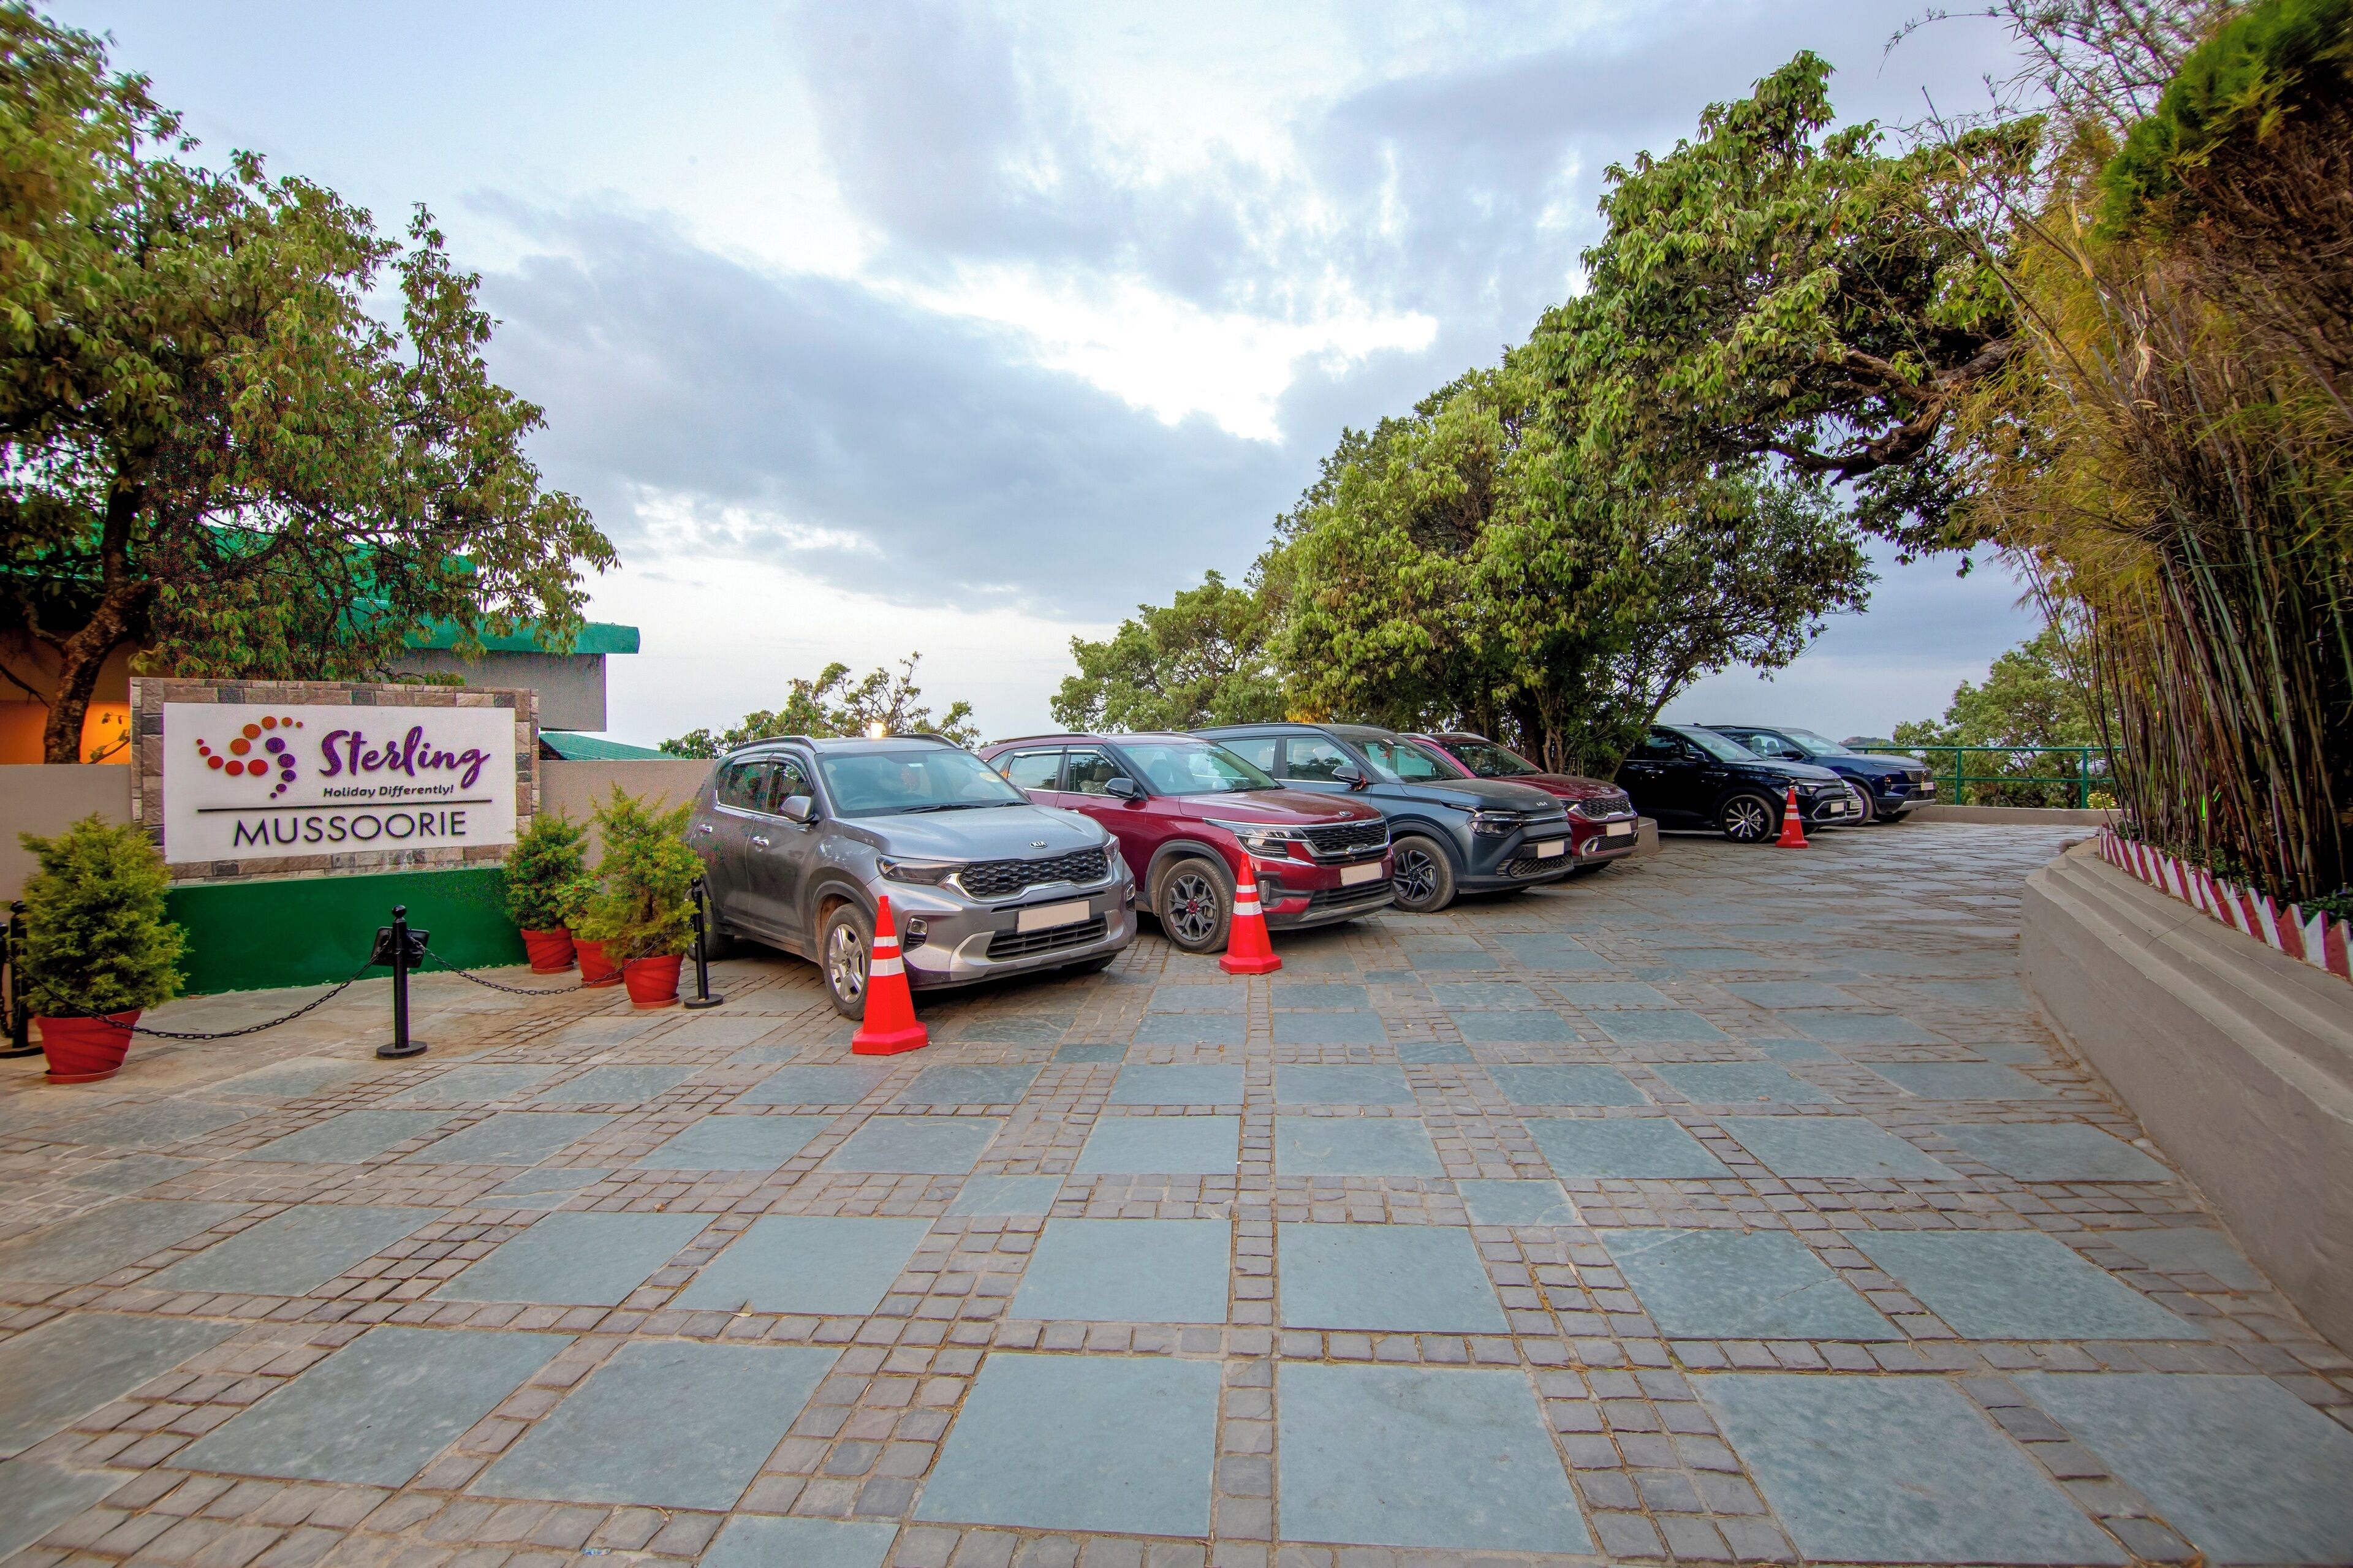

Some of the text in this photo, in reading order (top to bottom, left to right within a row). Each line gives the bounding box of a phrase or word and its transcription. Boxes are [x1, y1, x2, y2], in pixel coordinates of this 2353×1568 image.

[319, 725, 490, 789] Sterling
[324, 784, 453, 798] Holiday Differently!
[233, 811, 466, 847] MUSSOORIE
